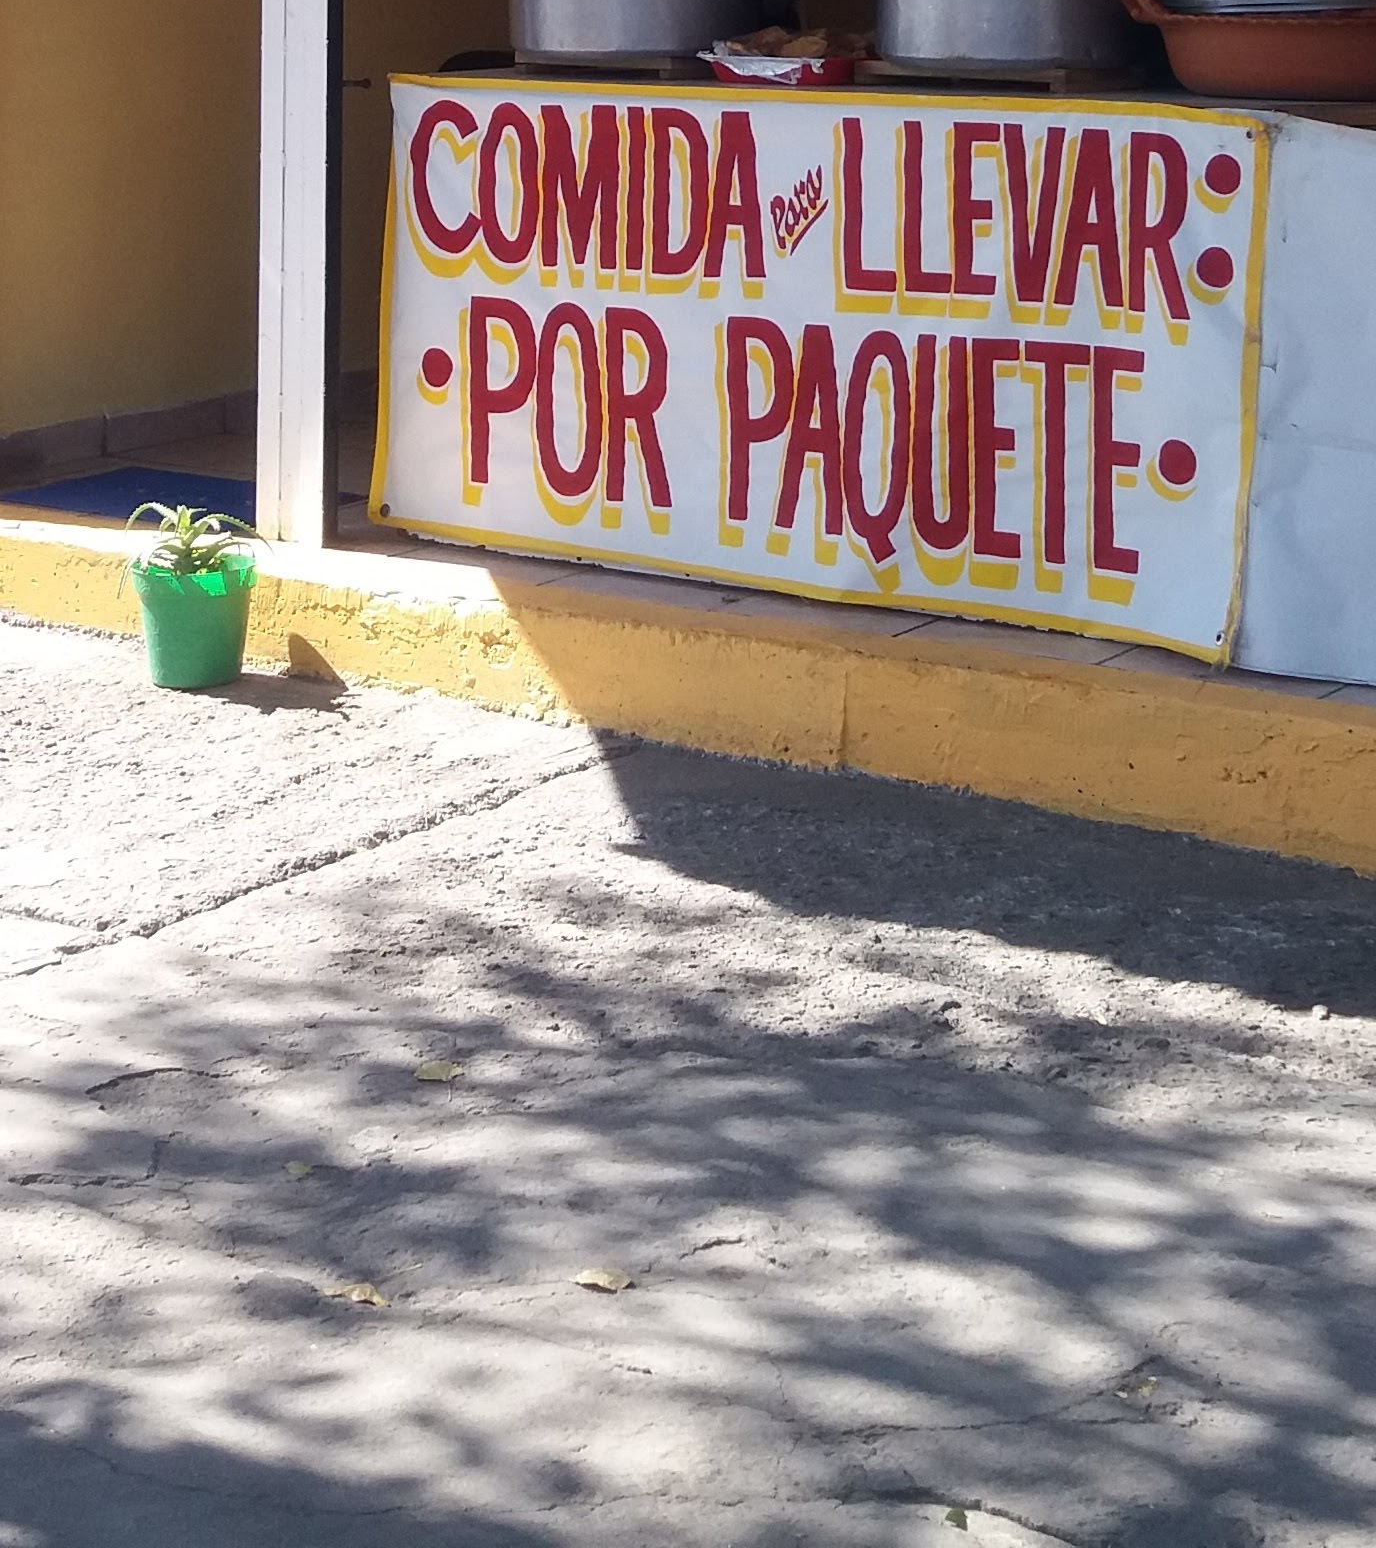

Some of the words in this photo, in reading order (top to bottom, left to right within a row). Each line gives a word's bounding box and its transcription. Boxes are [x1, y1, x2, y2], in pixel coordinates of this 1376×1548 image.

[407, 99, 767, 284] COMIDA
[468, 295, 672, 512] POR
[724, 314, 1145, 577] PAQUETE
